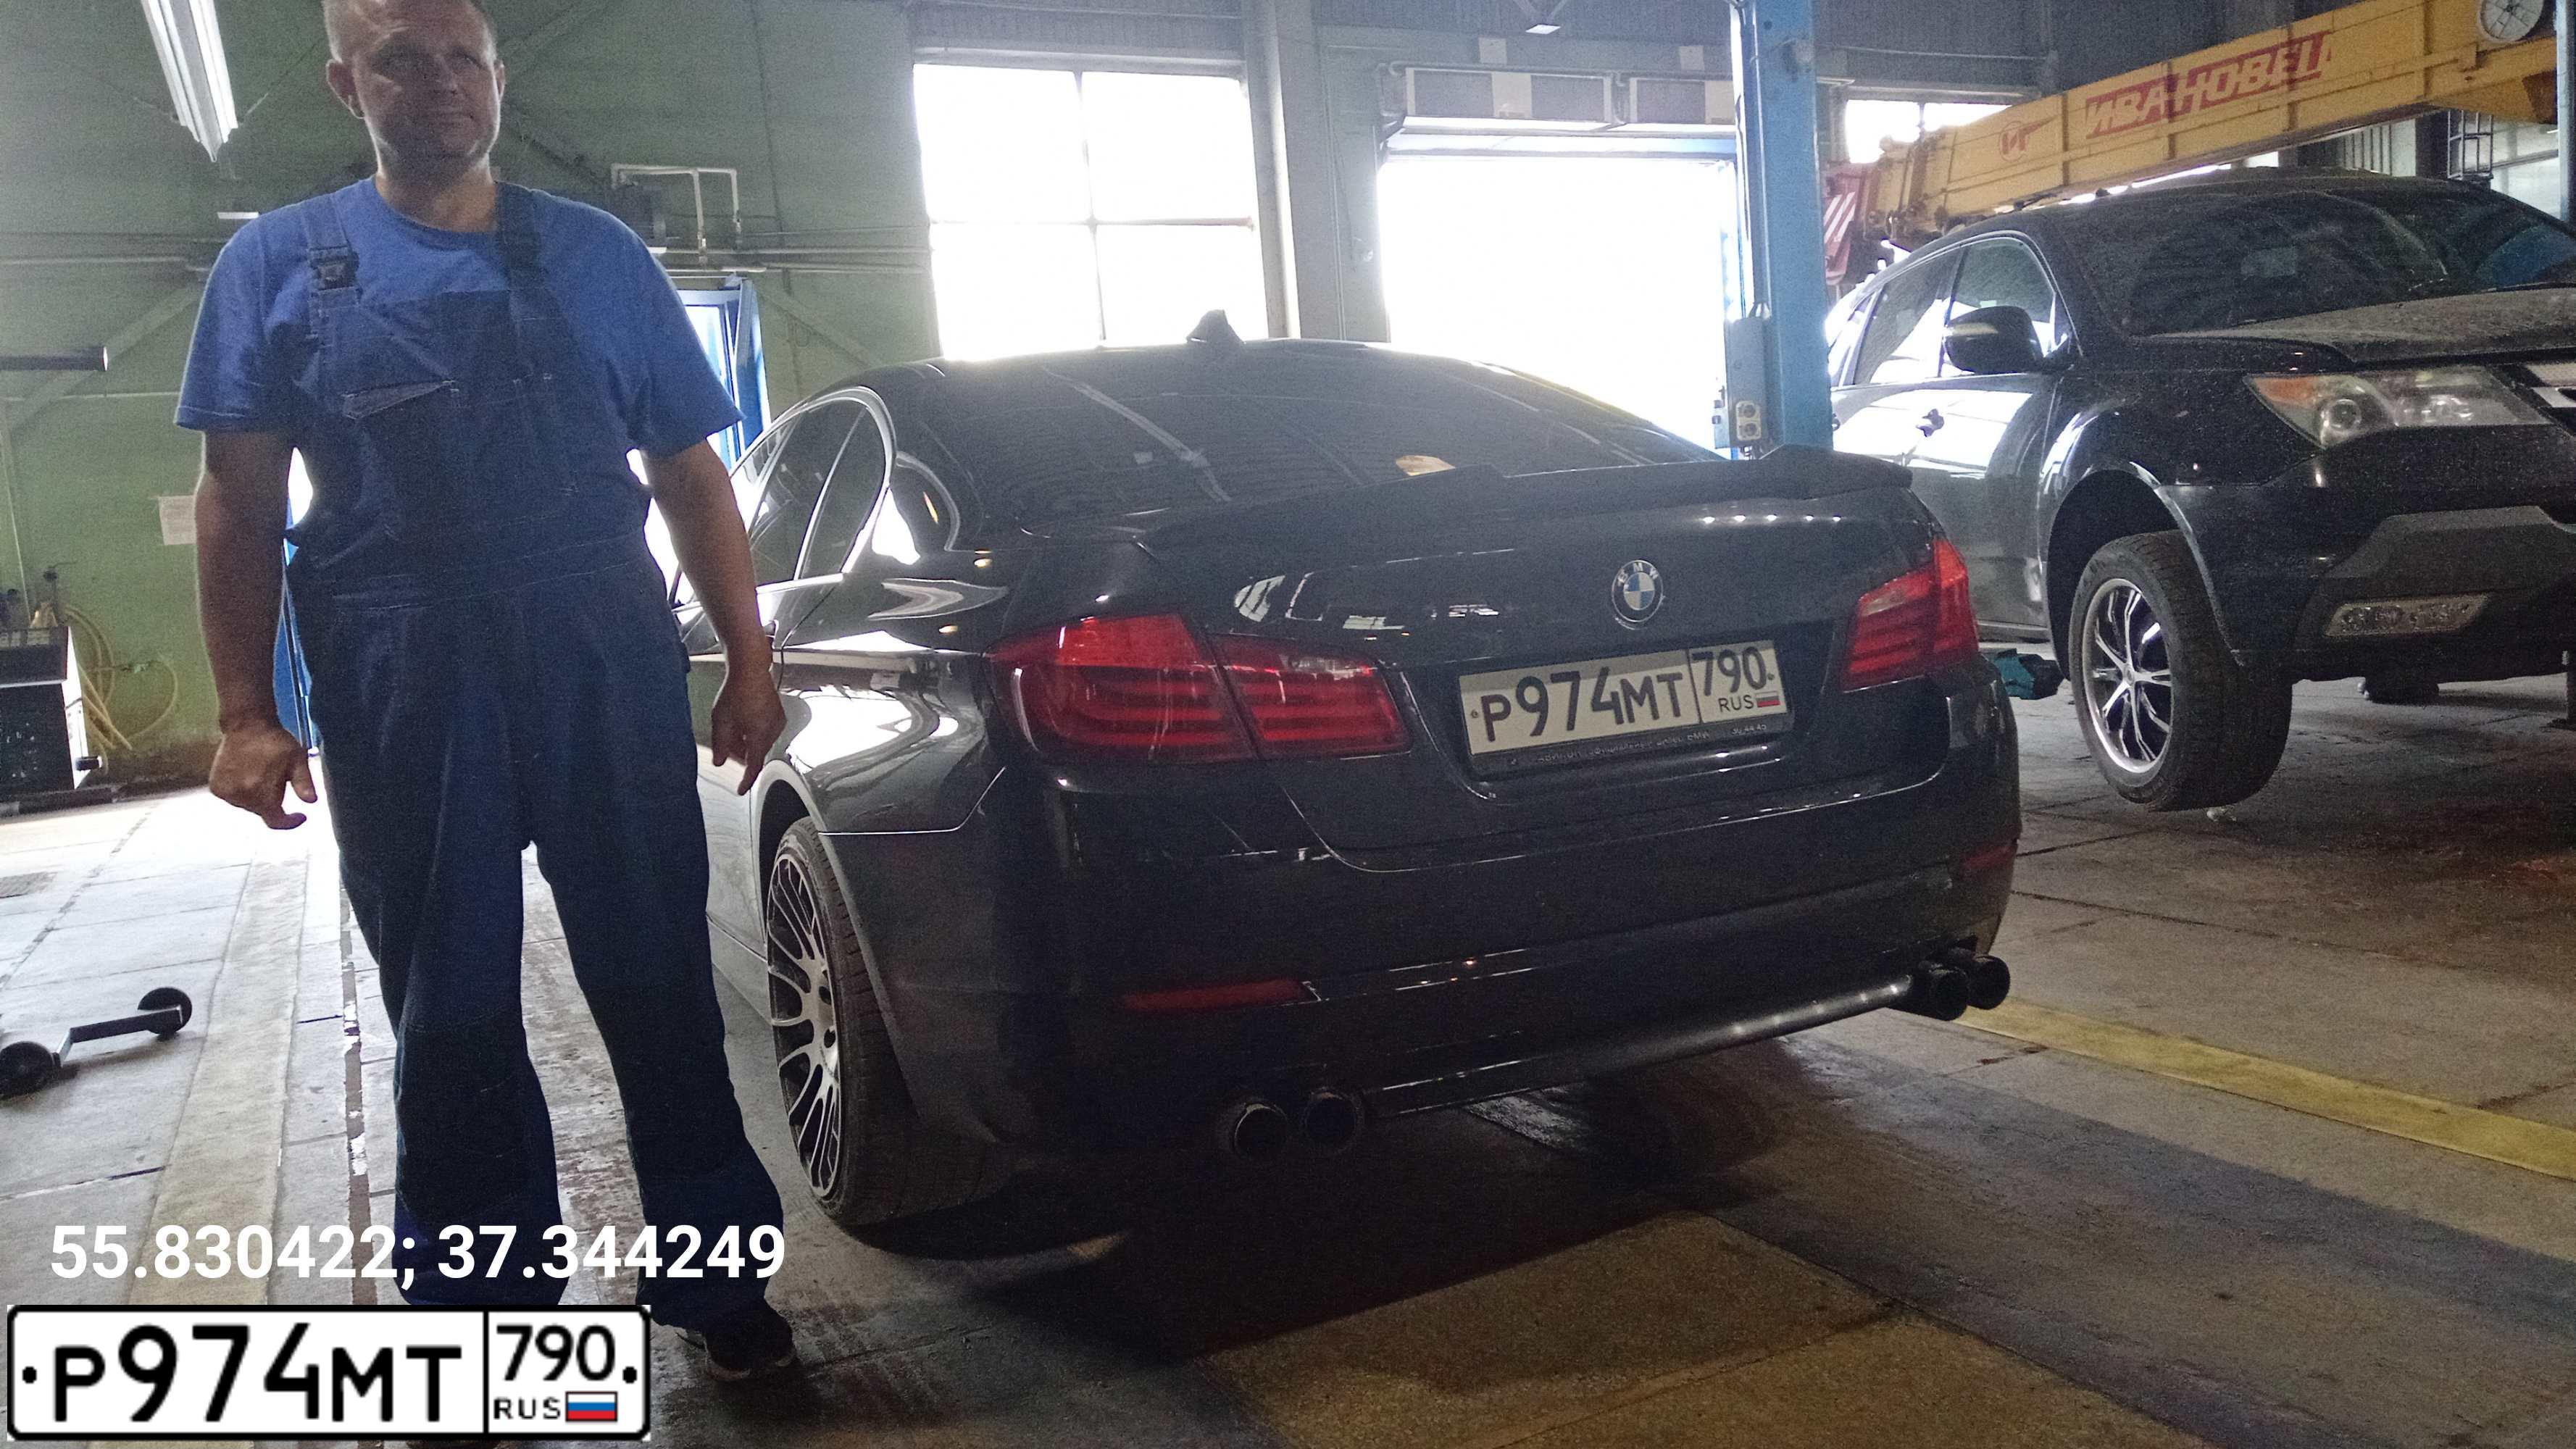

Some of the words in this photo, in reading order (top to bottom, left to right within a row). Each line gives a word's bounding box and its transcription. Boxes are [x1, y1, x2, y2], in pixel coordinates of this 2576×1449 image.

[2084, 33, 2332, 136] ИВАНОВЕЦ
[1617, 561, 1659, 587] BMW
[1480, 666, 1683, 743] Р974МТ
[1691, 646, 1767, 697] 790
[1717, 693, 1755, 712] RUS
